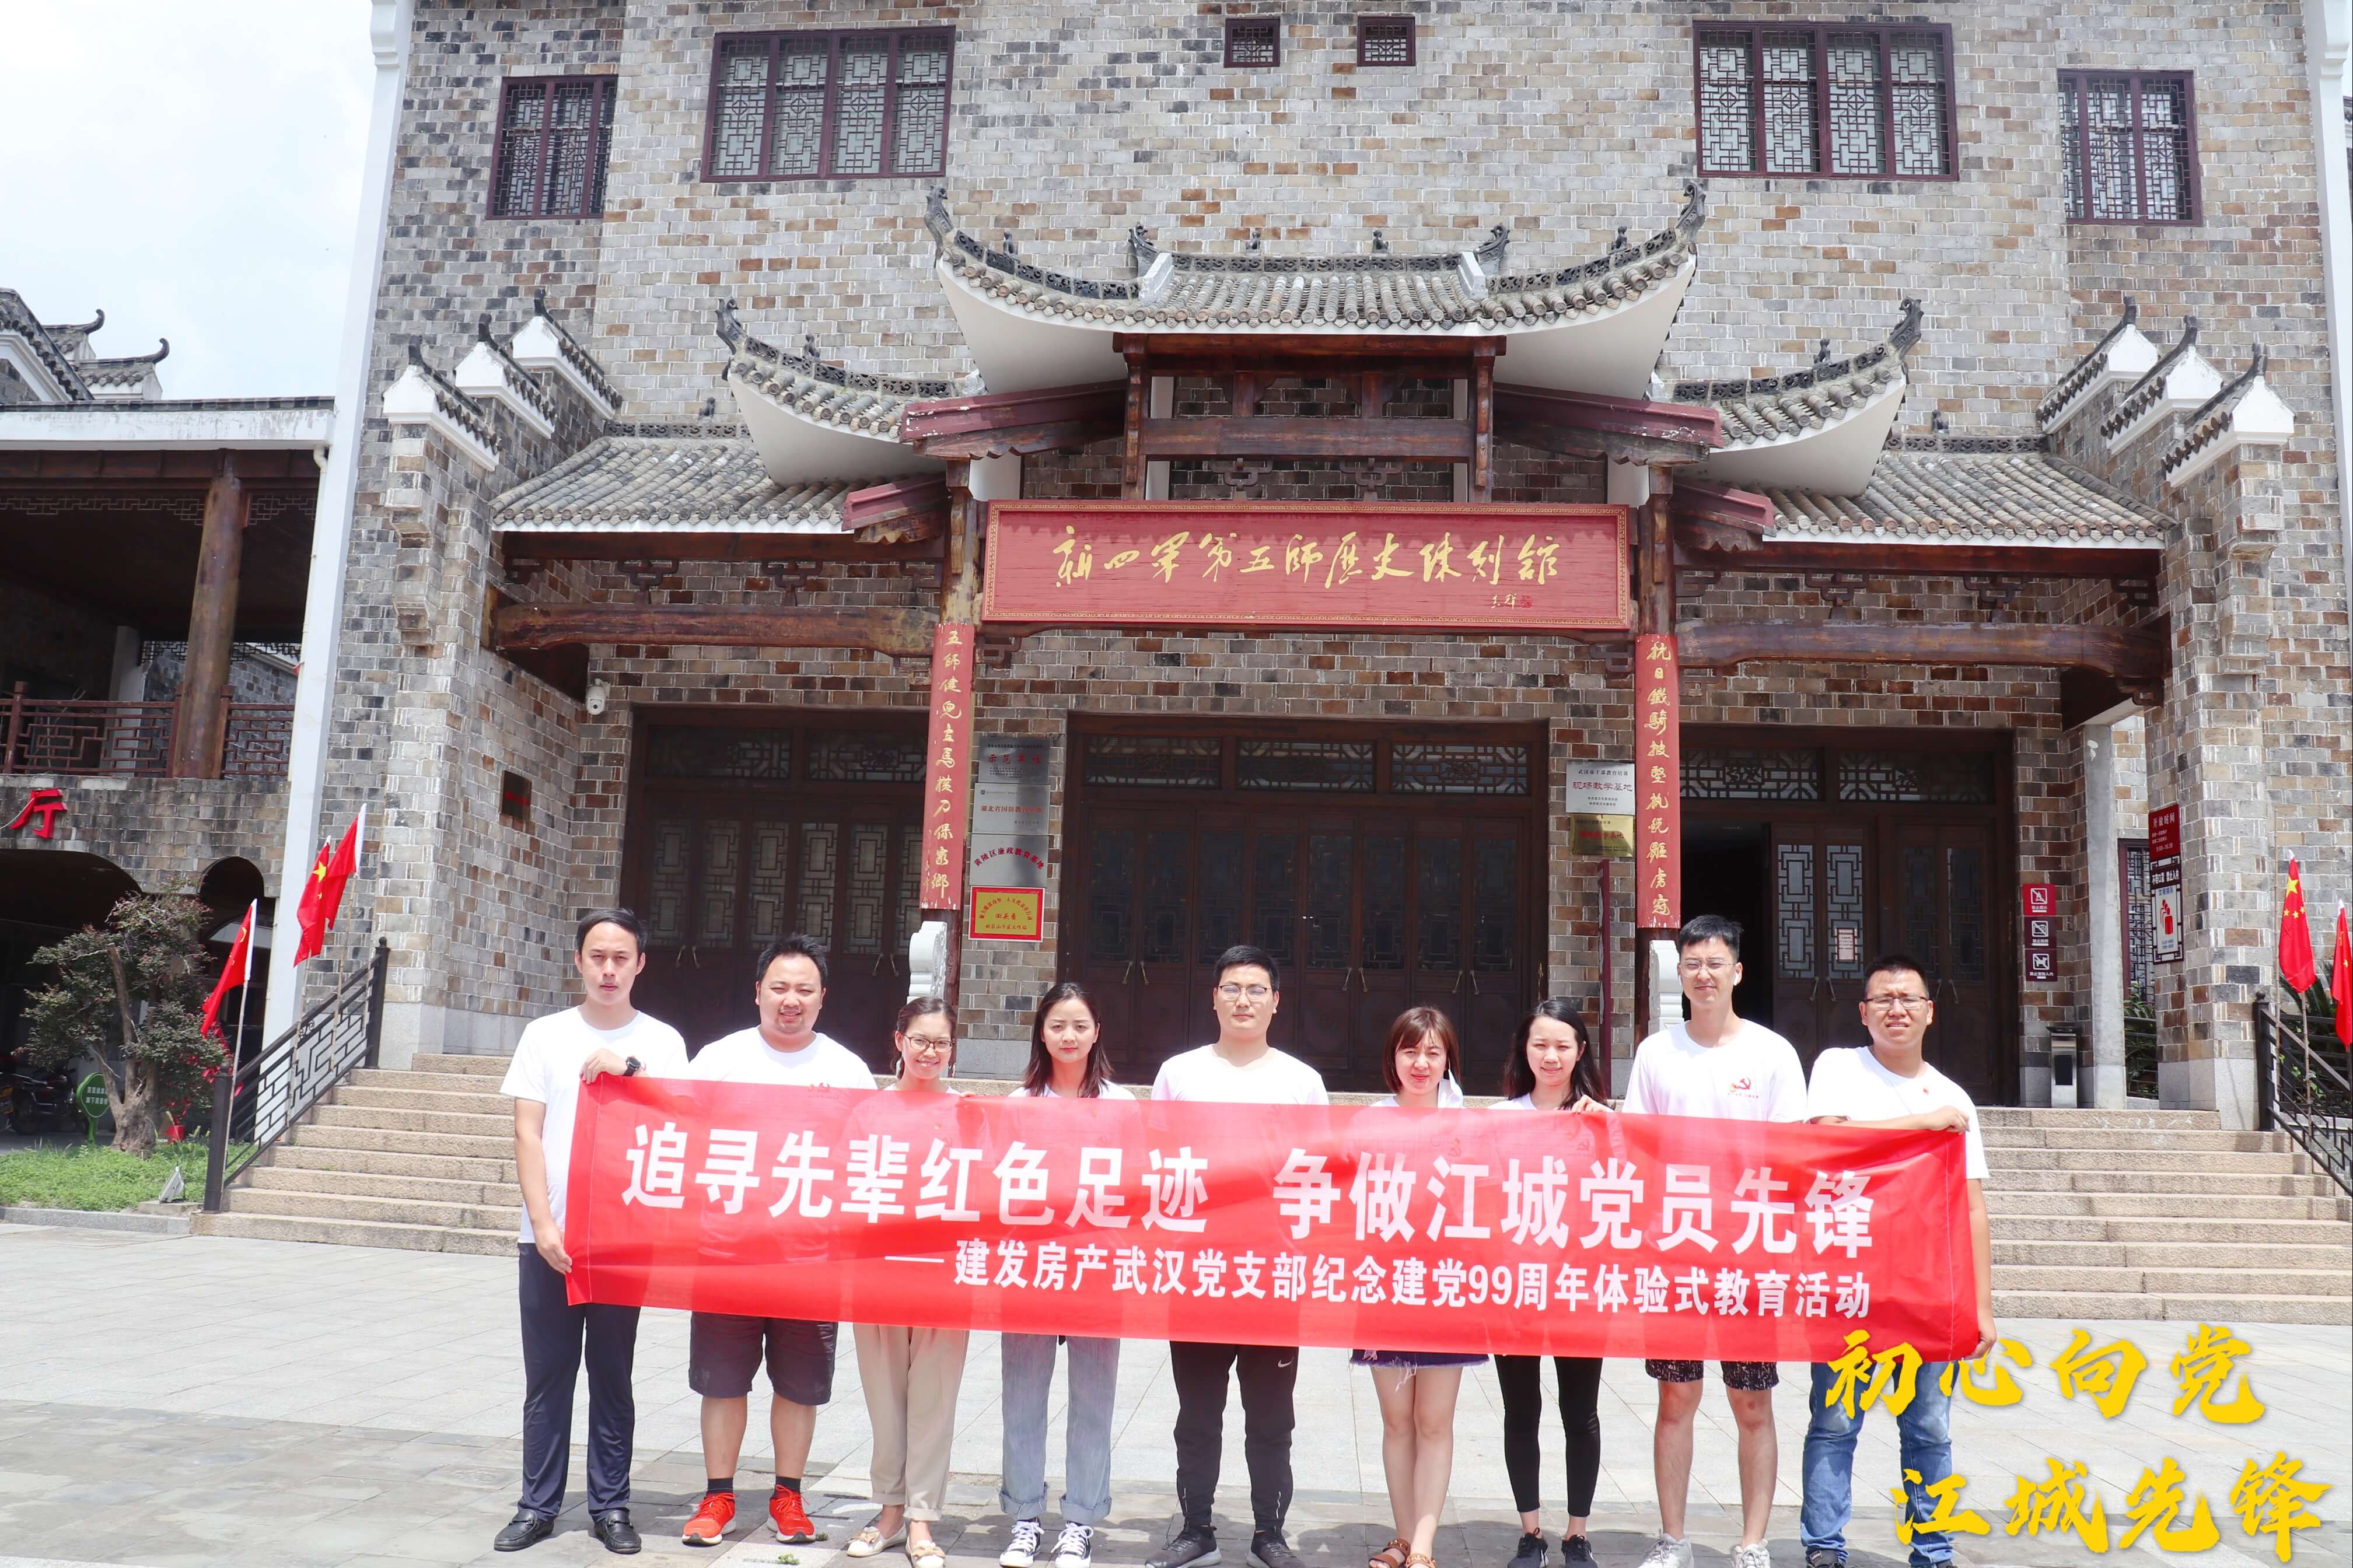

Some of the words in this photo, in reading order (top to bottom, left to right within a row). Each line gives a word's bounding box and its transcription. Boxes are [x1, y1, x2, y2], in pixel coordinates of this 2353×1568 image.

[1572, 781, 1634, 792] 现场教学基地
[9, 788, 69, 839] 厅
[621, 1121, 1209, 1233] 追寻先辈红色足迹
[1272, 1147, 1873, 1258] 争做江城党员先锋
